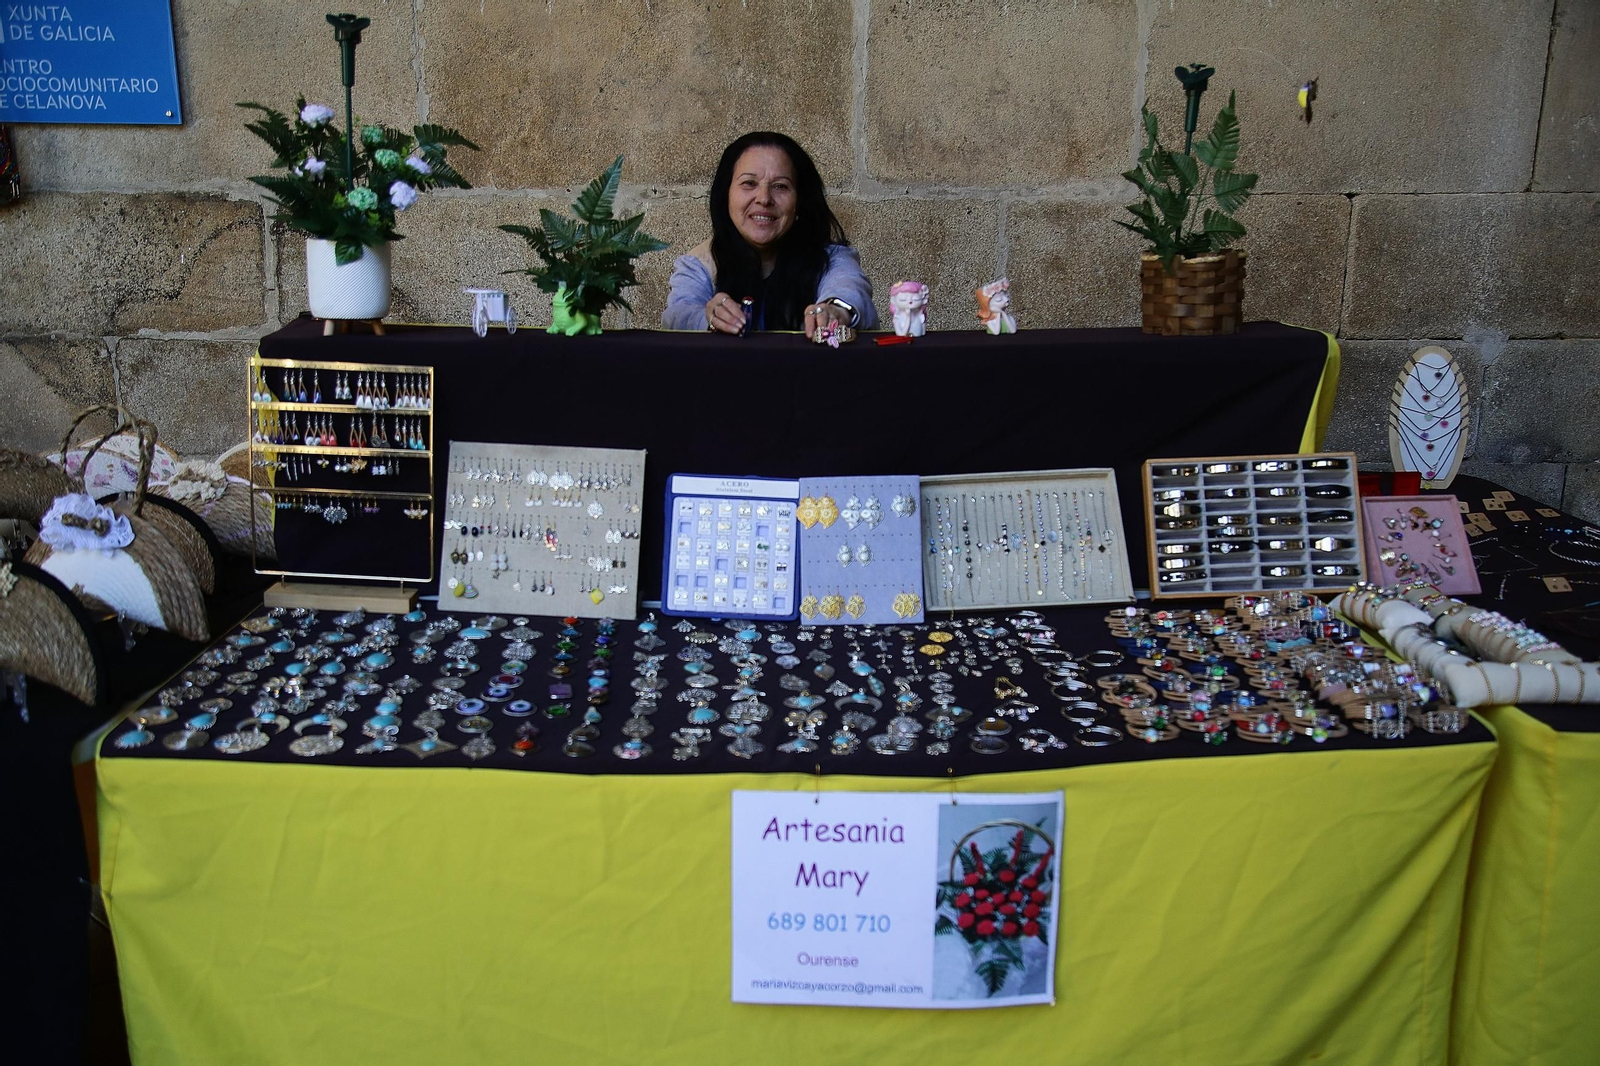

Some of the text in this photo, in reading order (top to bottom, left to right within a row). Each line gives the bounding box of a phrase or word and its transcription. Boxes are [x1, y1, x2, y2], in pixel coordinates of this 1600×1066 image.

[8, 5, 73, 22] XUNTA
[9, 25, 116, 42] DE GALICIA
[0, 59, 52, 75] NTRO
[13, 94, 107, 110] CELANOVA
[762, 816, 905, 844] Artesania
[795, 862, 869, 897] Mary
[767, 912, 892, 933] 689 801 710
[797, 951, 860, 968] Ourense
